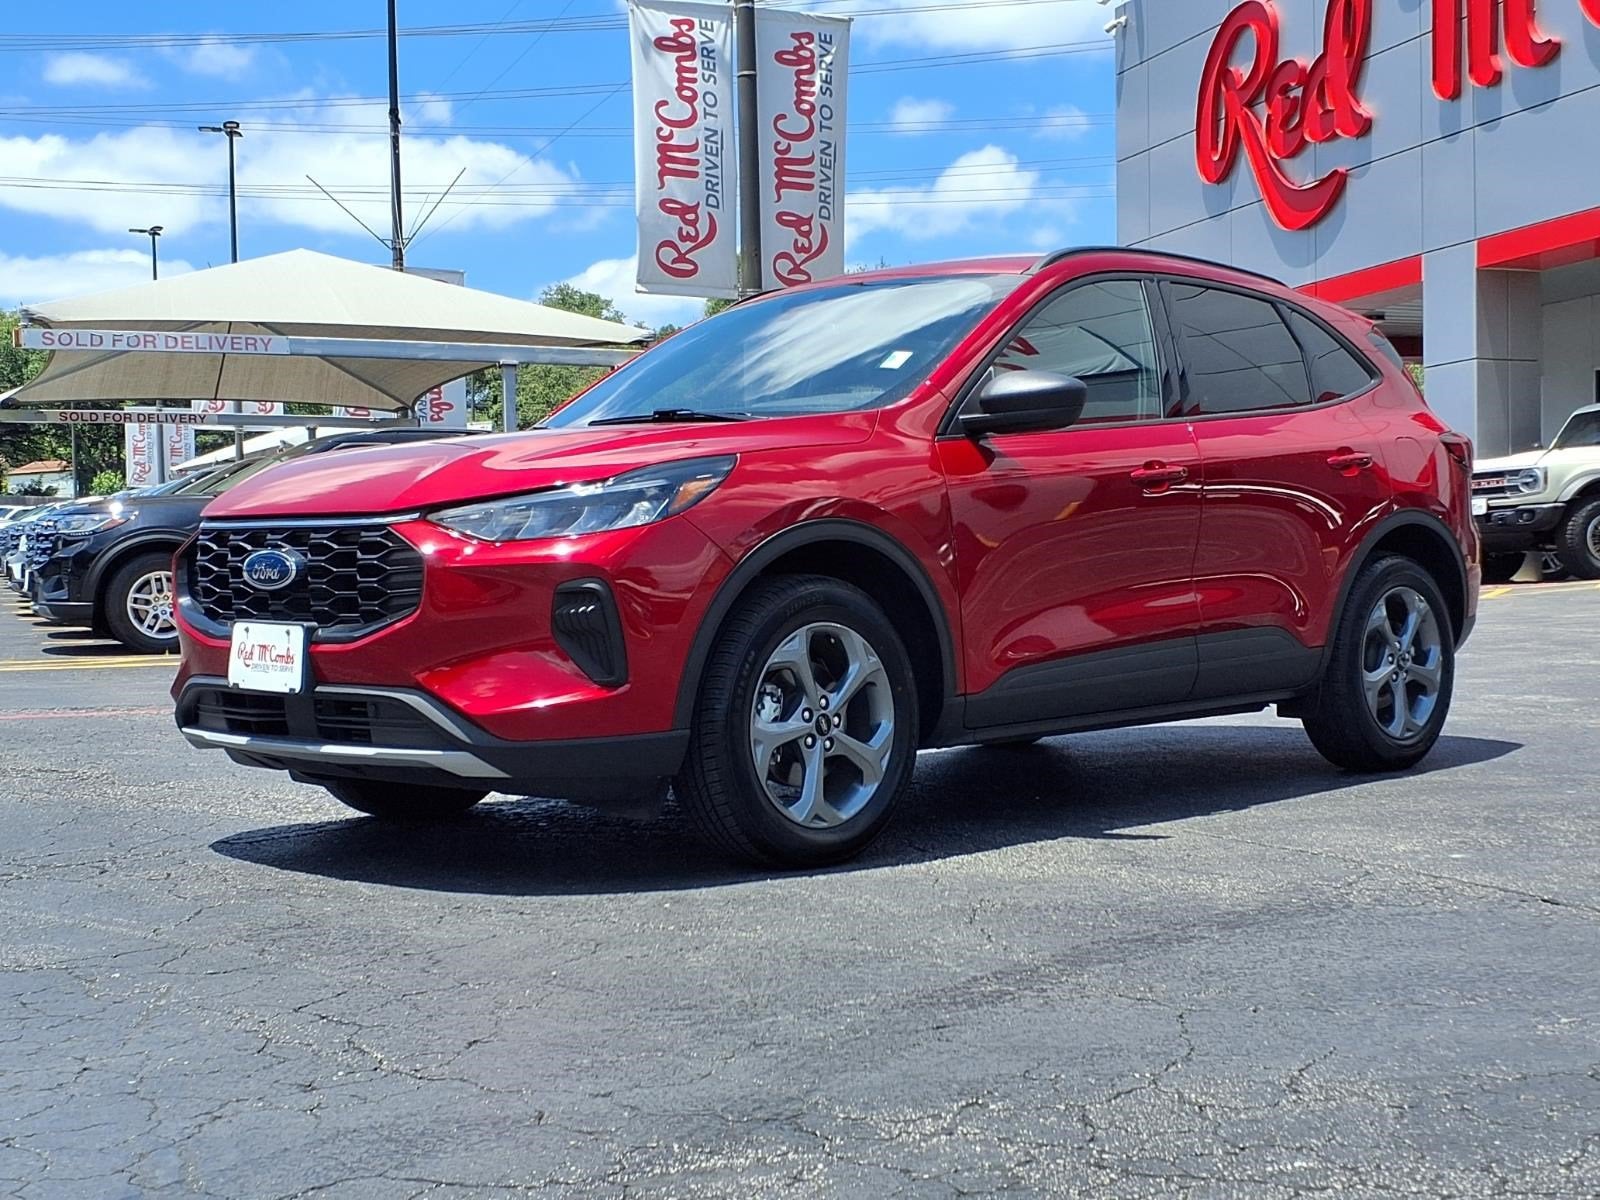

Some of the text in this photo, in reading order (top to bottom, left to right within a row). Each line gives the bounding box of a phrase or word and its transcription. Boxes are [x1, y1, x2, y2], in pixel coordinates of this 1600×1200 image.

[699, 18, 720, 210] DRIVEN TO SERVE
[818, 32, 833, 221] DRIVEN TO SERVE
[1195, 0, 1374, 231] Red
[653, 18, 718, 279] Red McCombs
[773, 31, 829, 287] Red McCombs
[41, 331, 273, 352] SOLD FOR DELIVERY
[59, 411, 208, 424] SOLD FOR DELIVERY
[418, 395, 428, 422] RVE
[132, 423, 146, 459] McCom
[252, 559, 281, 580] Ford
[237, 641, 295, 667] Red McCombs
